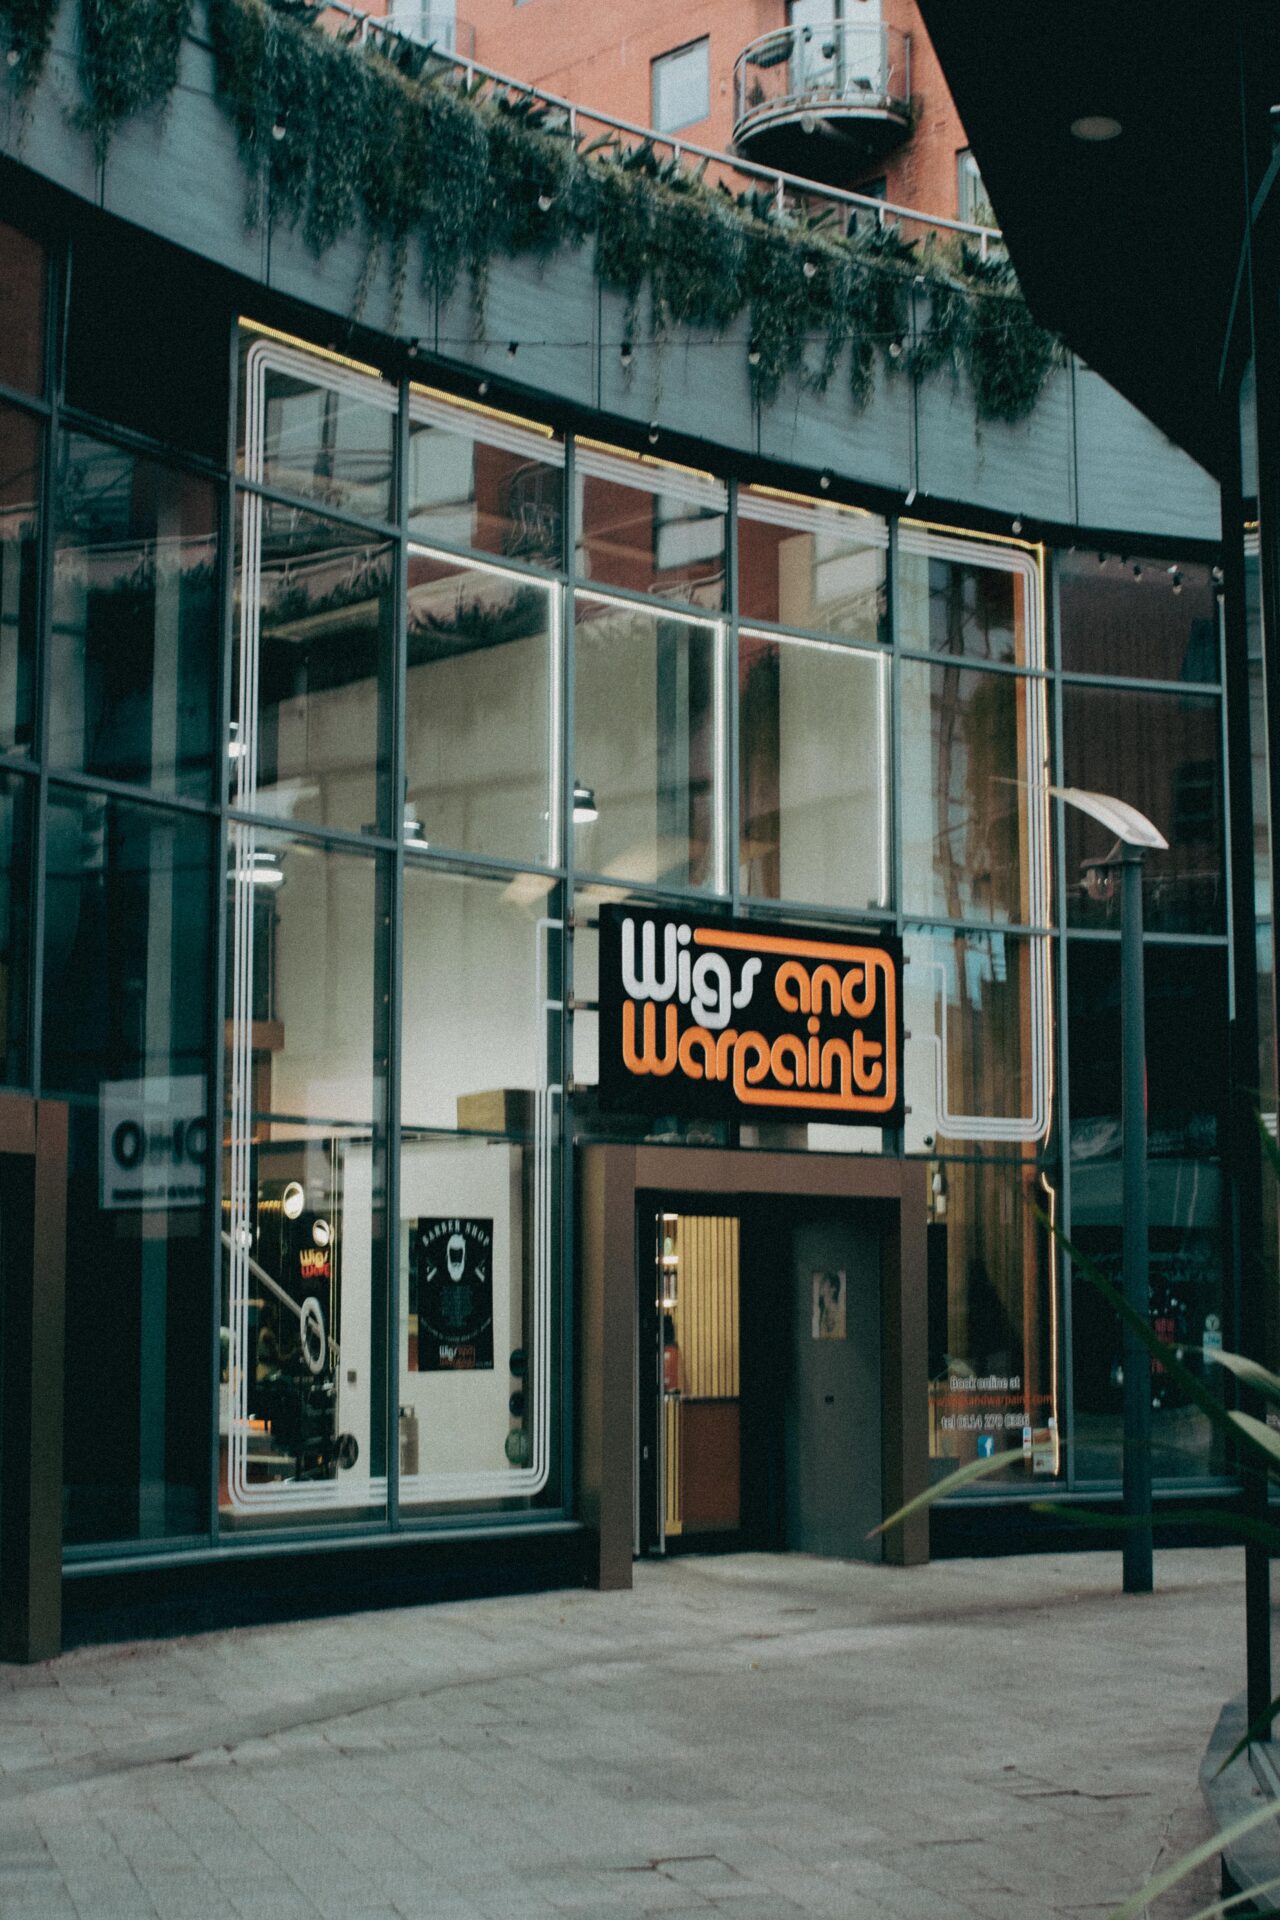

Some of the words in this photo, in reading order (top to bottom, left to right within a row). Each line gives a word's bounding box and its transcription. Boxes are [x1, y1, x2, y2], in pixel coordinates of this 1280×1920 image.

[621, 917, 763, 1030] Wigs
[774, 954, 877, 1018] and
[622, 999, 884, 1102] Warpaint
